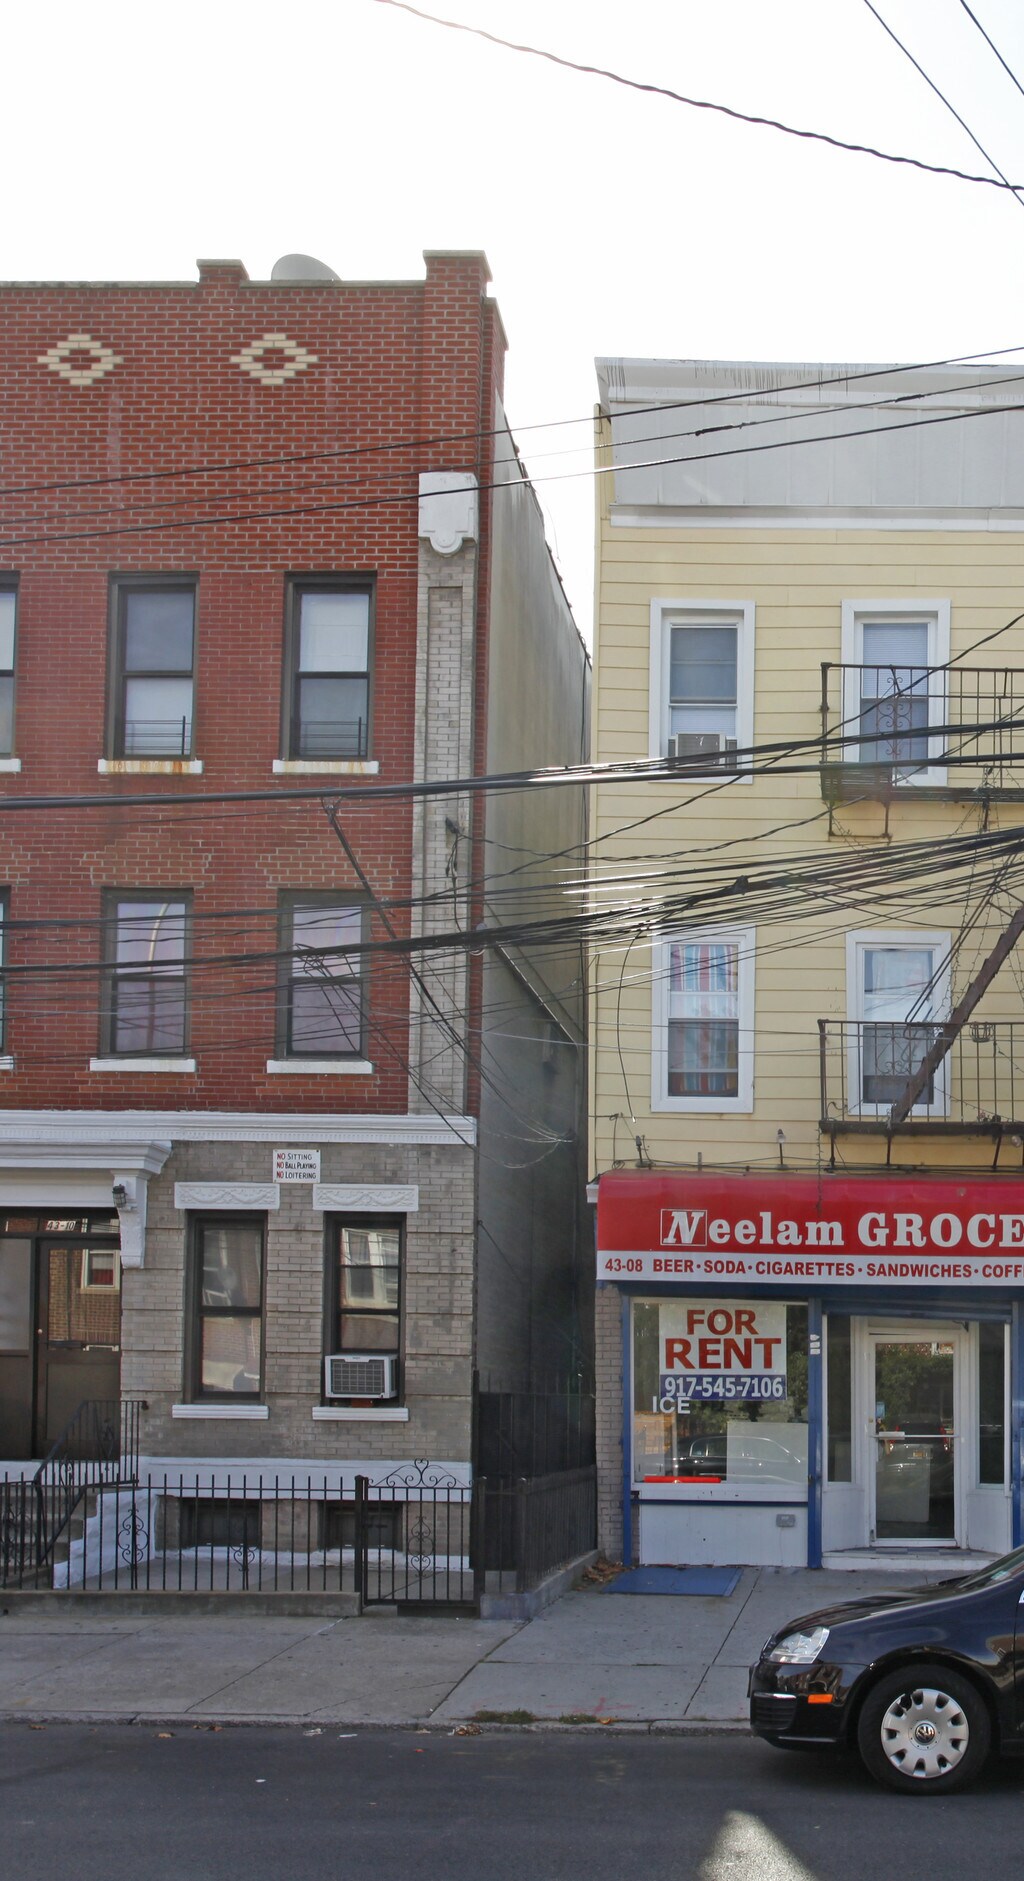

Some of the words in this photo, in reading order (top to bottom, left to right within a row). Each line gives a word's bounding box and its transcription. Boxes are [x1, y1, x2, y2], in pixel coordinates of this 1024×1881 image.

[277, 1171, 284, 1179] NO
[285, 1171, 316, 1179] LOITERING
[46, 1220, 75, 1231] 43-10
[662, 1211, 845, 1247] Neelam
[605, 1258, 643, 1272] 43-08
[653, 1259, 694, 1273] BEER
[704, 1259, 746, 1274] SODA
[755, 1261, 855, 1276] CIGARETTES
[866, 1263, 972, 1278] SANDWICHES
[686, 1309, 759, 1335] FOR
[665, 1338, 782, 1369] RENT
[664, 1376, 783, 1398] 917-545-7106
[652, 1395, 691, 1415] ICE
